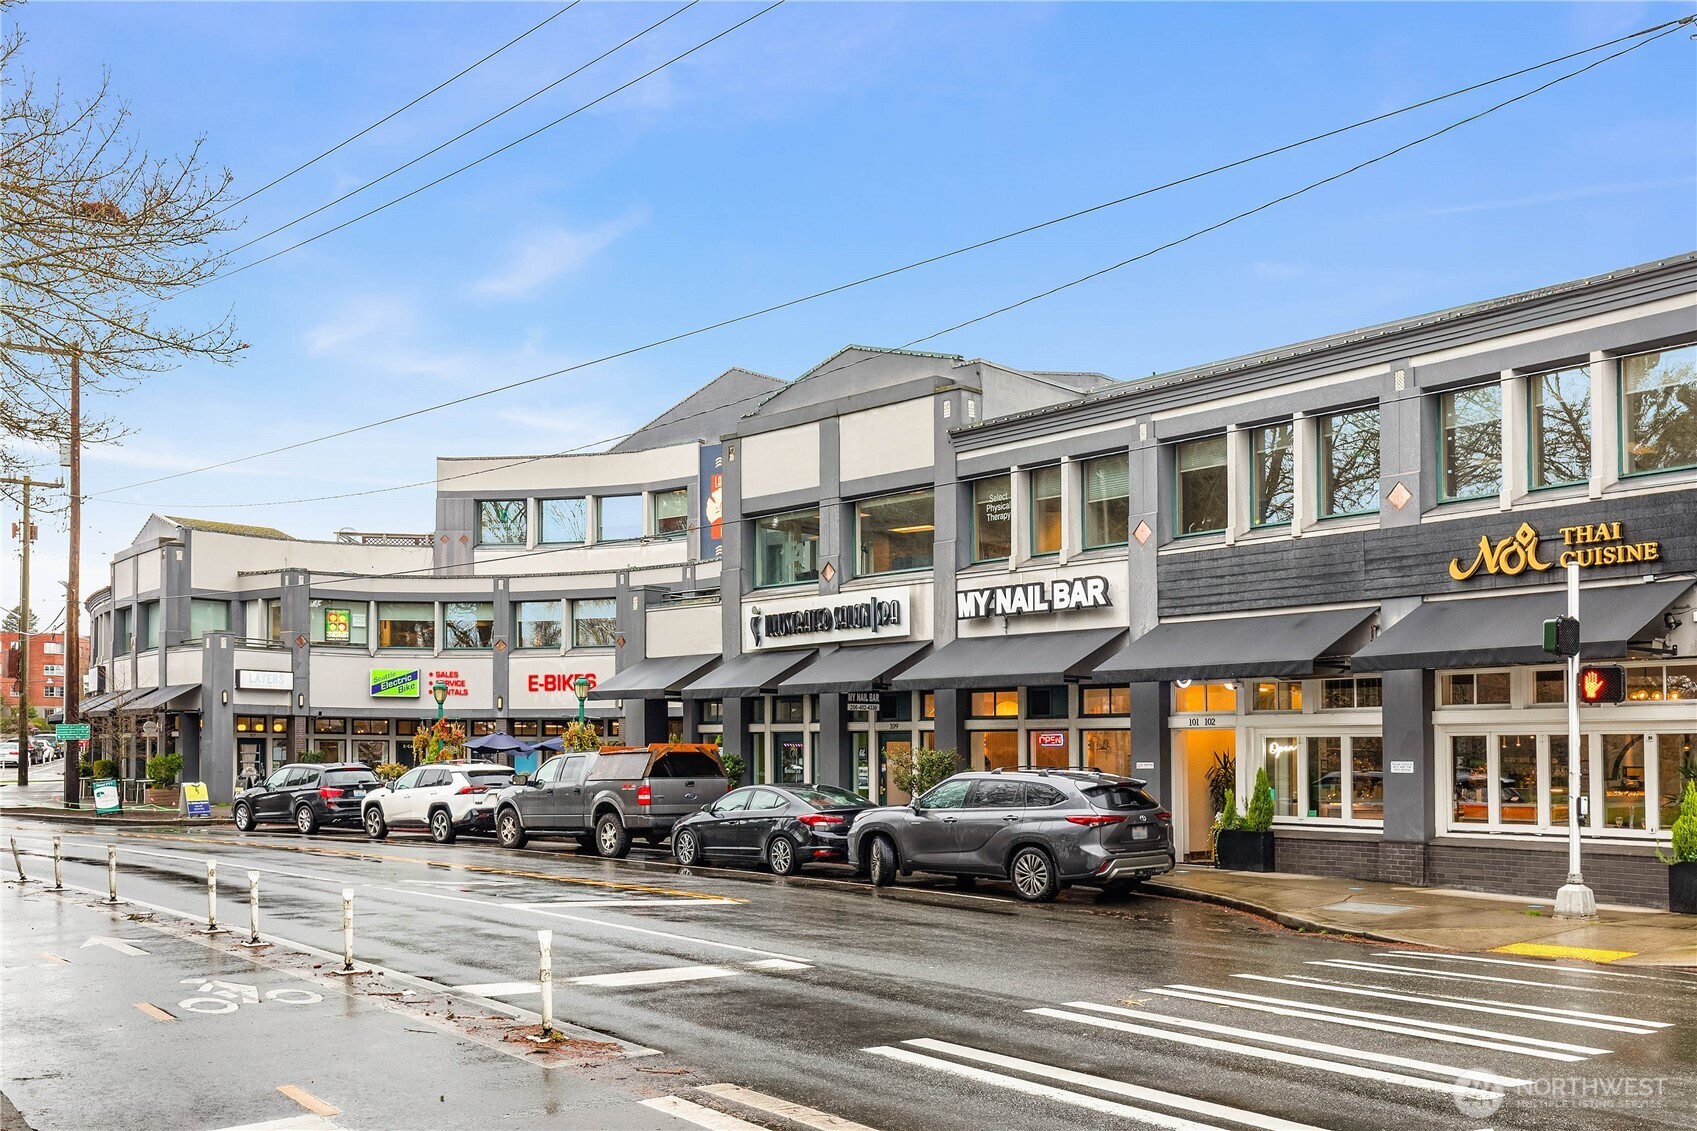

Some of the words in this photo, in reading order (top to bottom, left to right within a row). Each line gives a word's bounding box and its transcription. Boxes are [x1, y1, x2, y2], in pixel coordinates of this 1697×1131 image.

[989, 493, 1008, 502] Select
[986, 512, 1011, 522] Therapy
[1559, 521, 1622, 545] THAI
[1559, 541, 1659, 569] CUISINE
[957, 591, 993, 618] MY
[994, 584, 1049, 615] NAIL
[1052, 577, 1109, 611] BAR
[248, 673, 284, 685] LAYERS
[373, 671, 397, 683] Seattle
[435, 671, 458, 679] SALES
[380, 674, 412, 690] Electric
[398, 682, 415, 694] Bike
[848, 693, 856, 701] MY
[856, 693, 868, 702] NAIL
[869, 693, 880, 702] BAR
[1188, 718, 1200, 726] 101
[1204, 717, 1216, 726] 102
[1039, 735, 1062, 744] OPEN
[1269, 741, 1298, 759] Open
